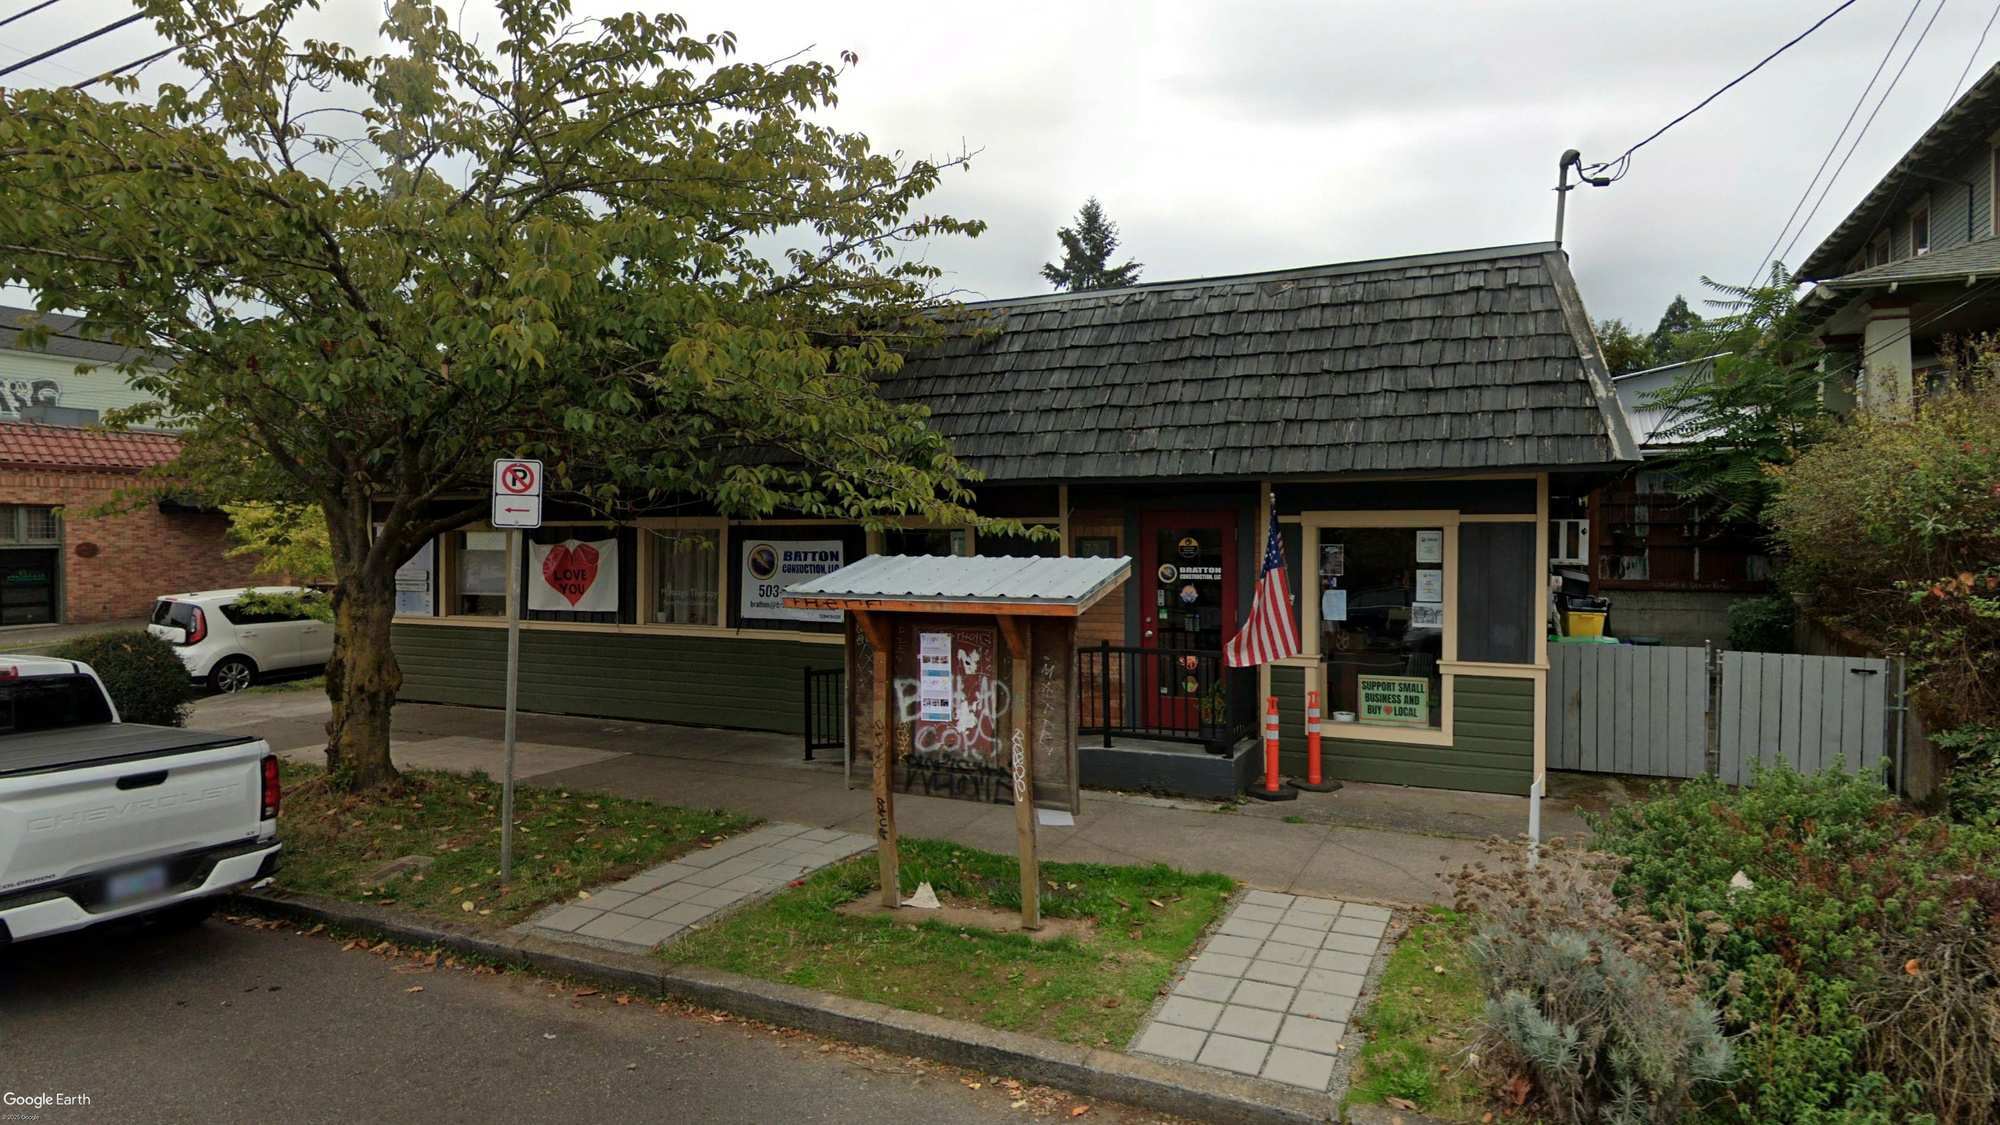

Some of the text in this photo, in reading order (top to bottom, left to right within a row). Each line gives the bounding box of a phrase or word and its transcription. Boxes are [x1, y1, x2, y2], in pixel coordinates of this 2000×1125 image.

[553, 569, 587, 581] LOVE
[560, 583, 586, 595] YOU
[1361, 681, 1425, 694] SUPPORT SMALL
[1365, 693, 1420, 705] BUSINESS AND
[1367, 705, 1418, 718] BUY LOCAL
[27, 784, 241, 833] CHEVROLET
[0, 873, 56, 890] OLORADO
